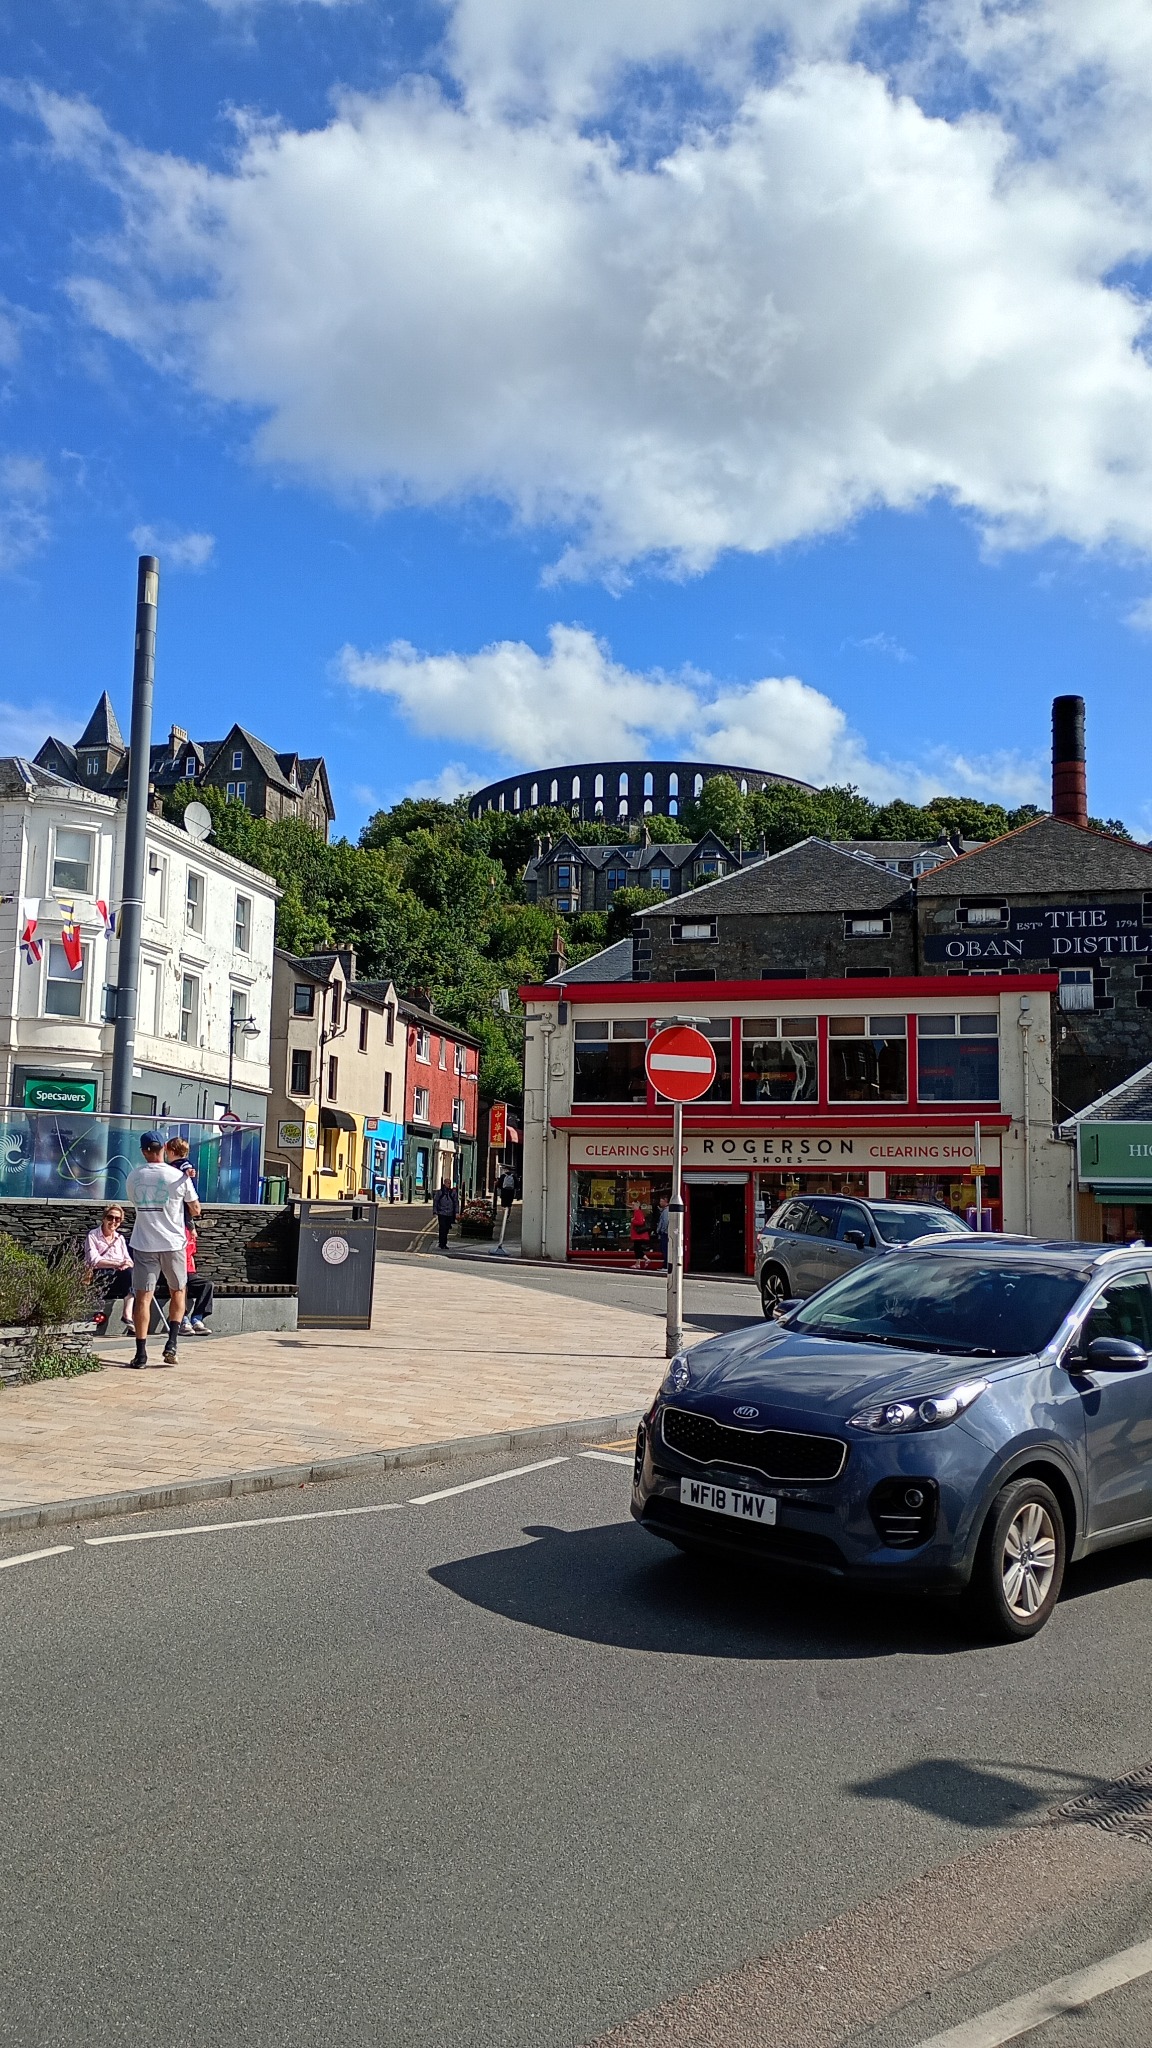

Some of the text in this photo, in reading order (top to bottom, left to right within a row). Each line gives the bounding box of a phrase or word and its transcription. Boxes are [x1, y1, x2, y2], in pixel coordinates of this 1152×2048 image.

[1045, 910, 1107, 928] THE
[1116, 920, 1138, 928] 1794
[946, 935, 1152, 957] OBAN DISTIL
[36, 1090, 86, 1102] Specsavers
[585, 1145, 649, 1157] CLEARING
[703, 1139, 853, 1154] ROGERSON
[869, 1146, 939, 1158] CLEARING
[737, 1406, 754, 1417] KIA
[690, 1482, 765, 1518] WF18 TMV
